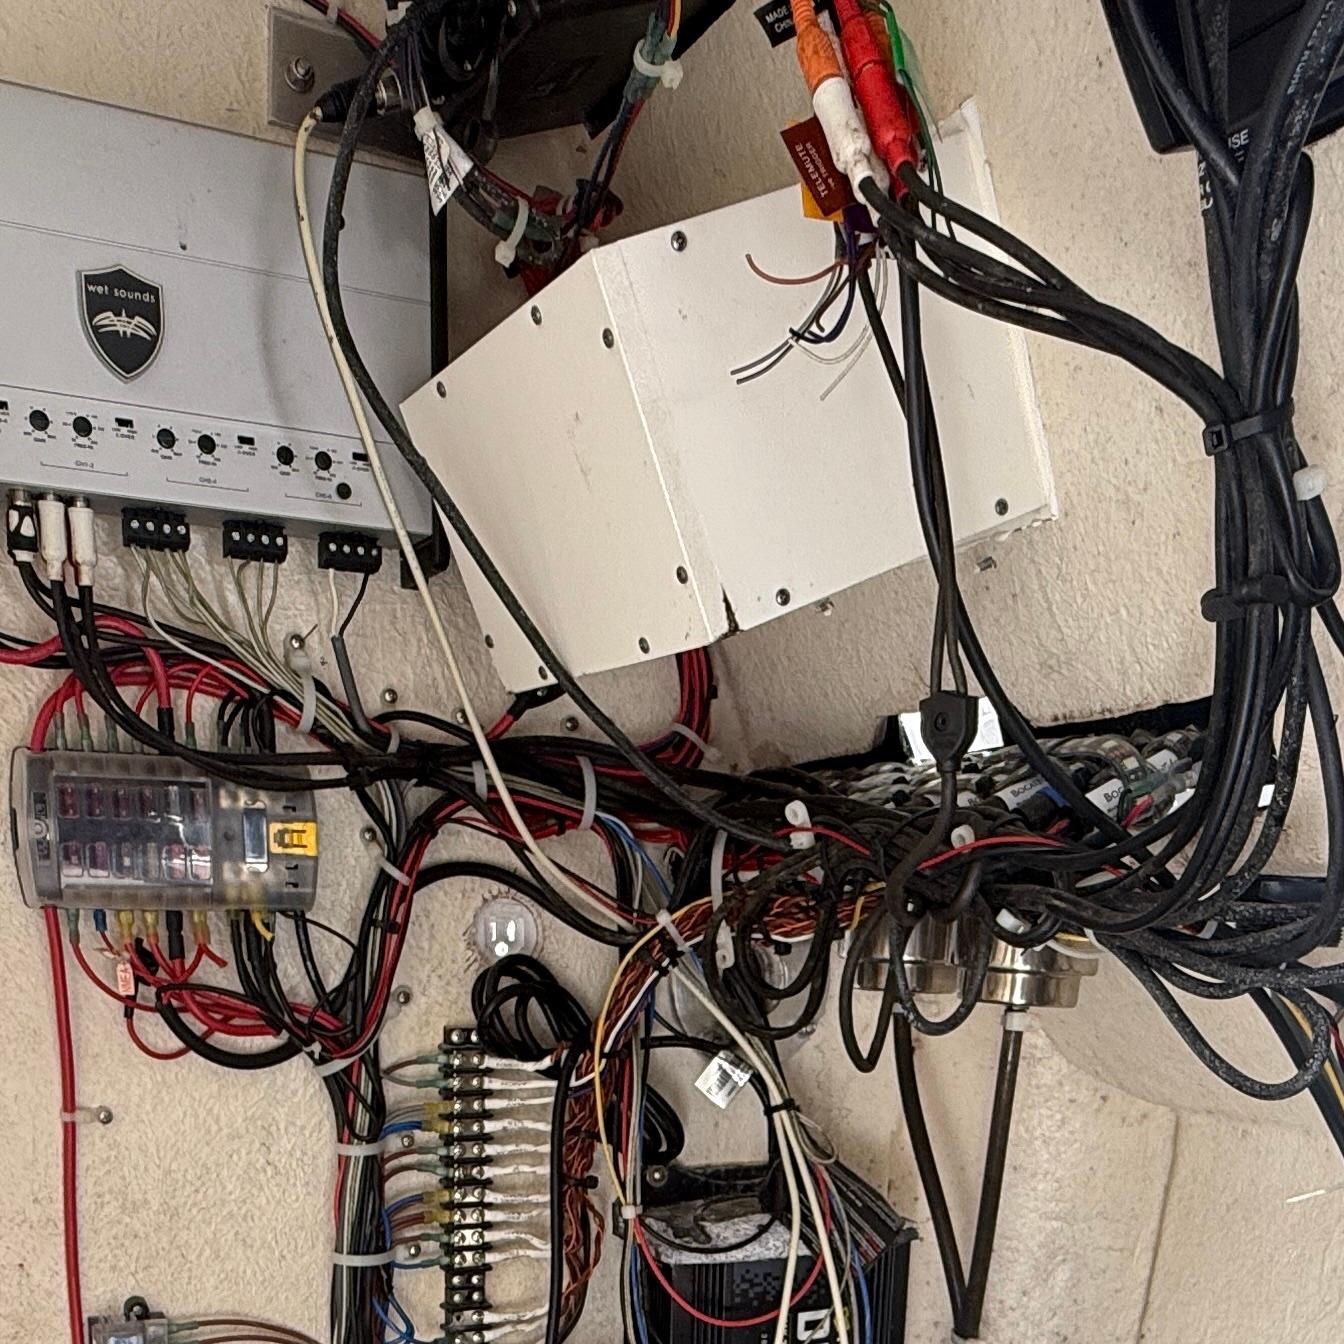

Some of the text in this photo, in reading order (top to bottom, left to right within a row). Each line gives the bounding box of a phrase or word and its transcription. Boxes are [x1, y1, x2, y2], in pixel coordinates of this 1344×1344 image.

[765, 5, 790, 23] MADE
[774, 19, 794, 33] CHIN
[806, 142, 829, 178] TRIGGER
[795, 142, 828, 199] TELEMUTE
[87, 283, 156, 303] wet sounds
